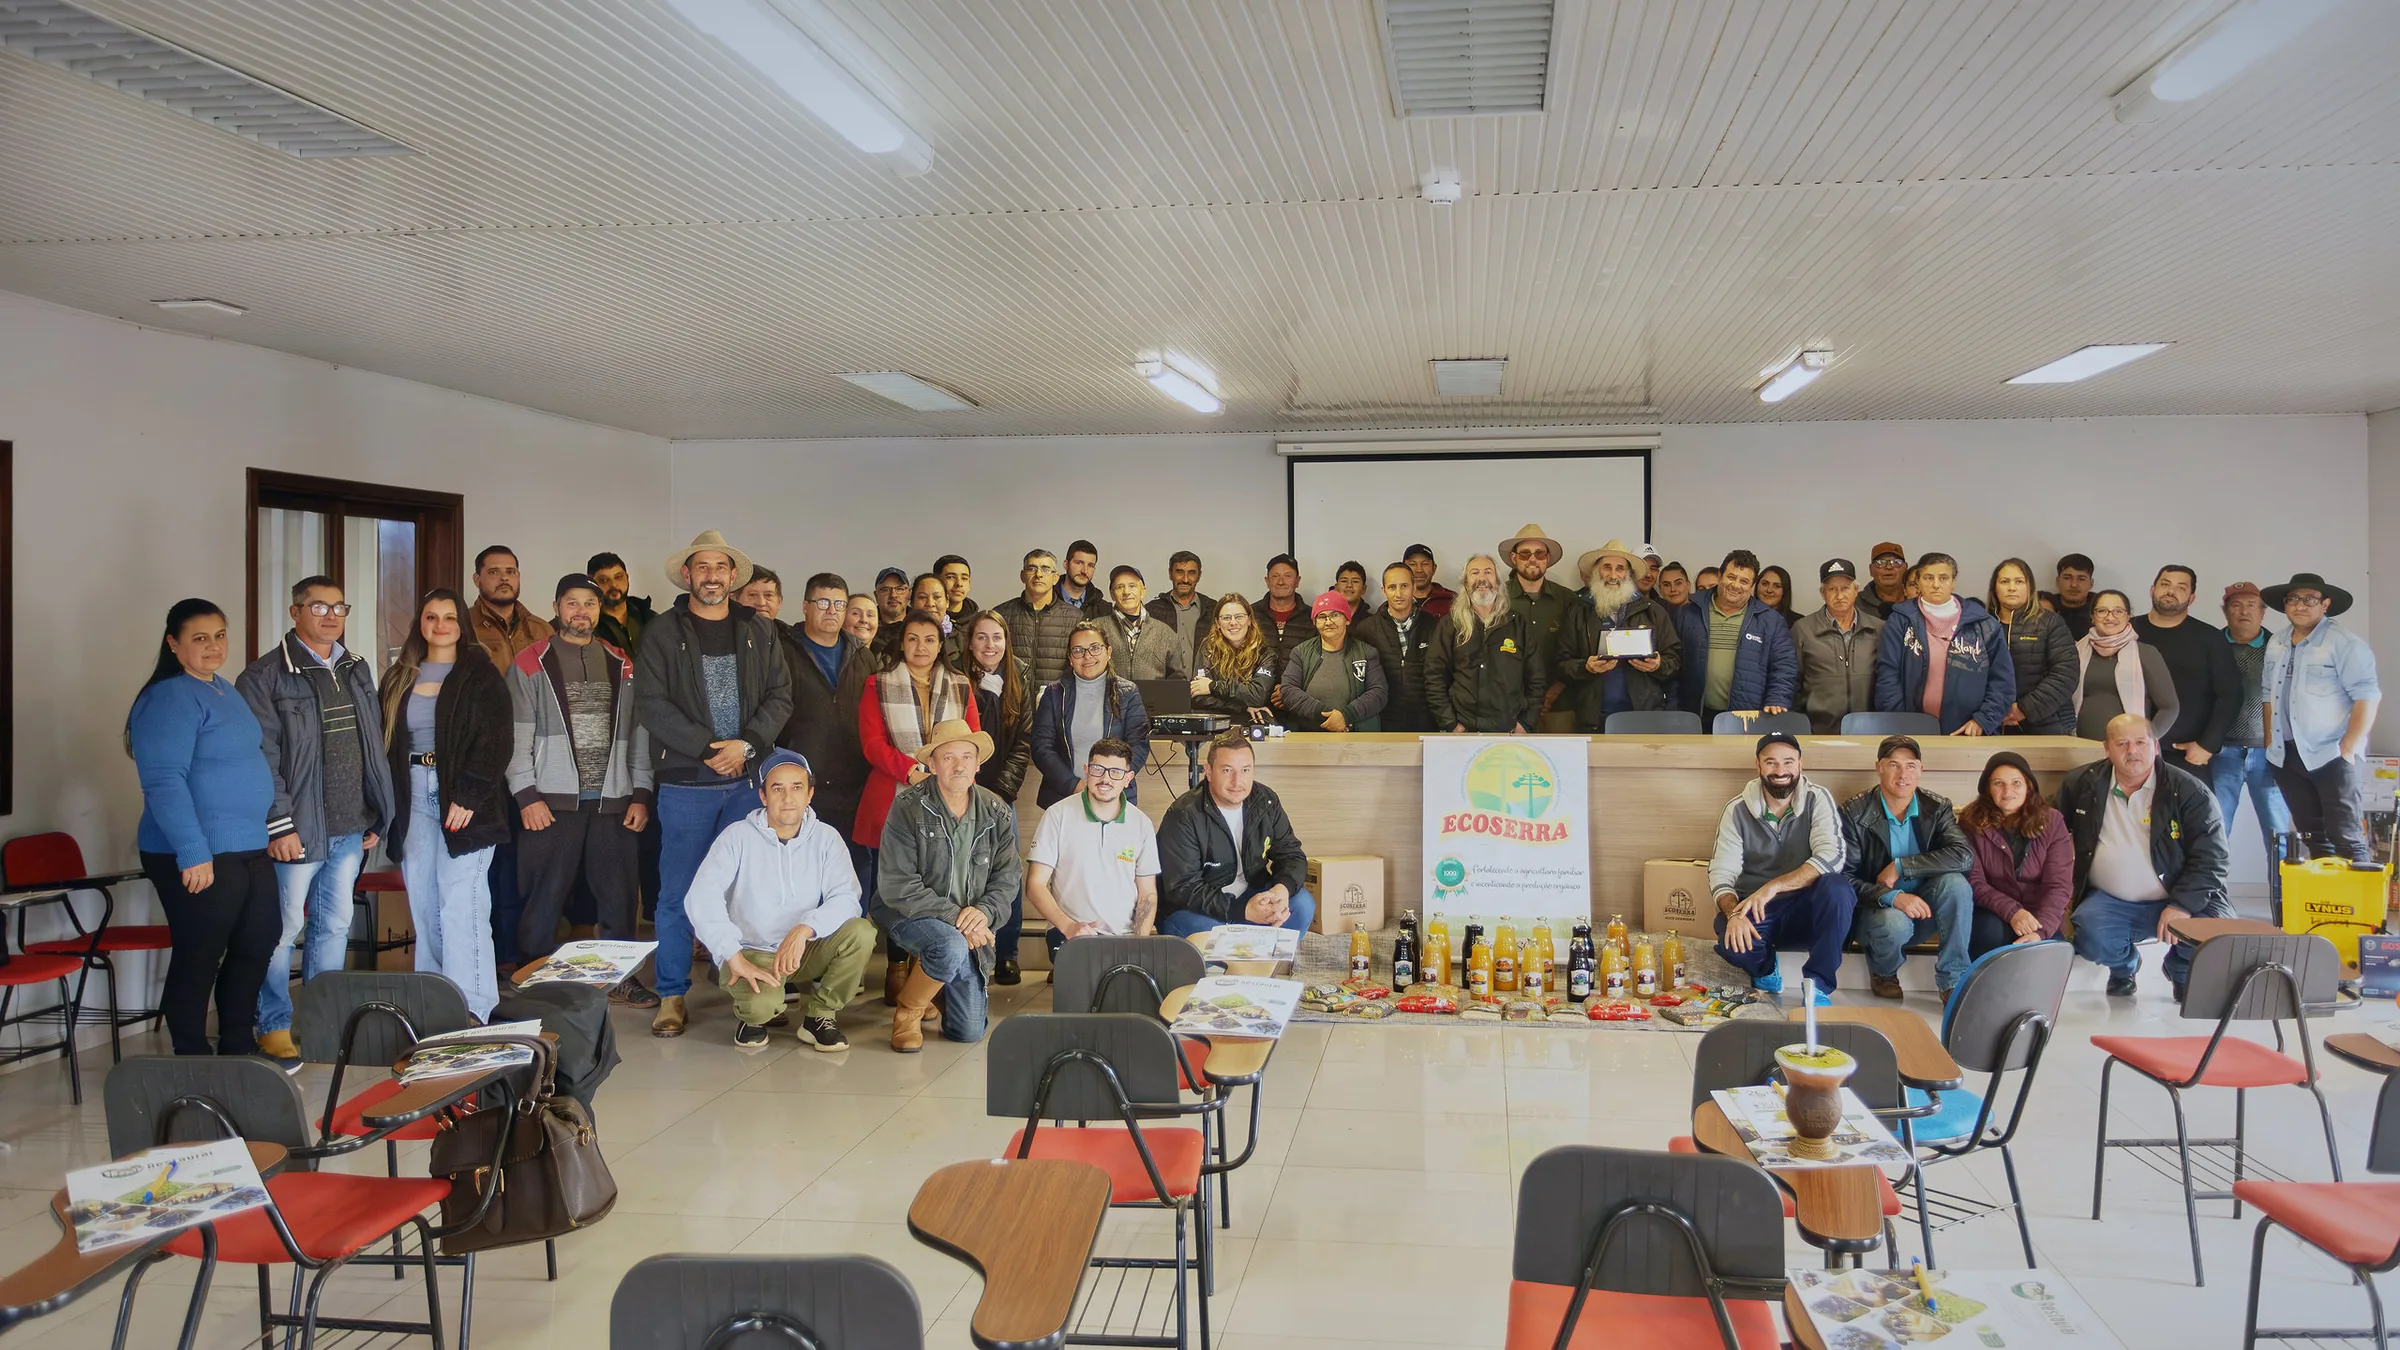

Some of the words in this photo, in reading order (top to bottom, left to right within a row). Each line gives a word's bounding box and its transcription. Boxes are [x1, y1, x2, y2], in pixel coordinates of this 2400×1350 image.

[1442, 813, 1568, 841] ECOSERRA
[2306, 903, 2352, 915] LYNUS
[147, 1151, 213, 1169] Resaurar
